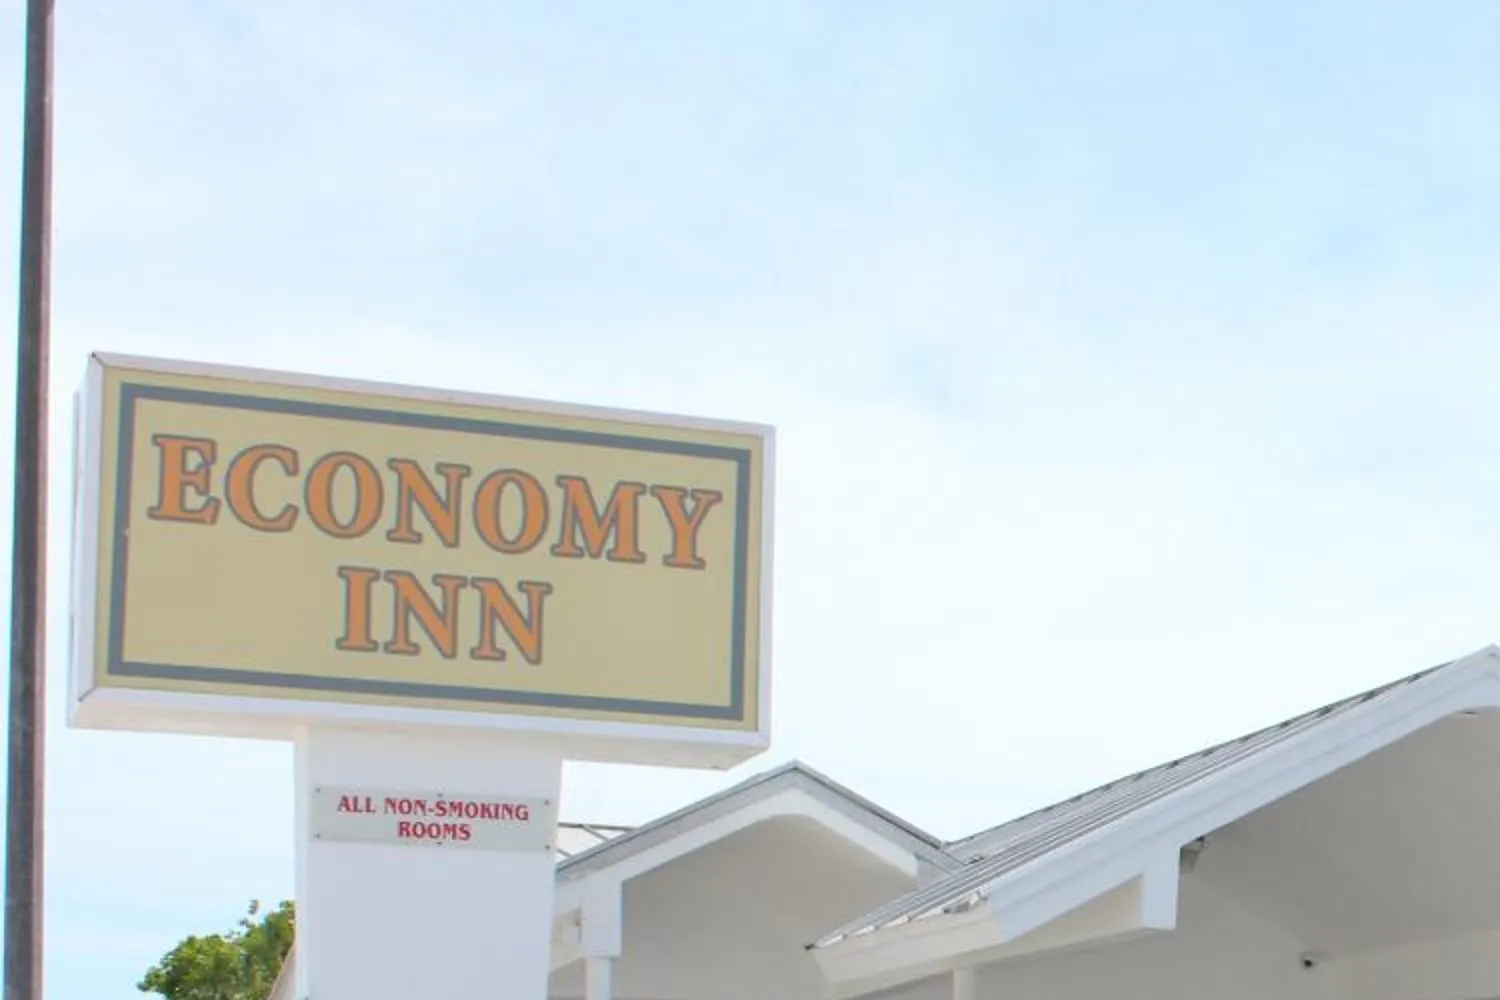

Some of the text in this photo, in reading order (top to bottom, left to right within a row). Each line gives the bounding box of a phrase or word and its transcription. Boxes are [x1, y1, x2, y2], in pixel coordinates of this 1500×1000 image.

[147, 434, 722, 570] ECONOMY
[336, 566, 552, 665] INN
[336, 795, 529, 821] ALL NON-SMOKING
[397, 820, 472, 841] ROOMS
